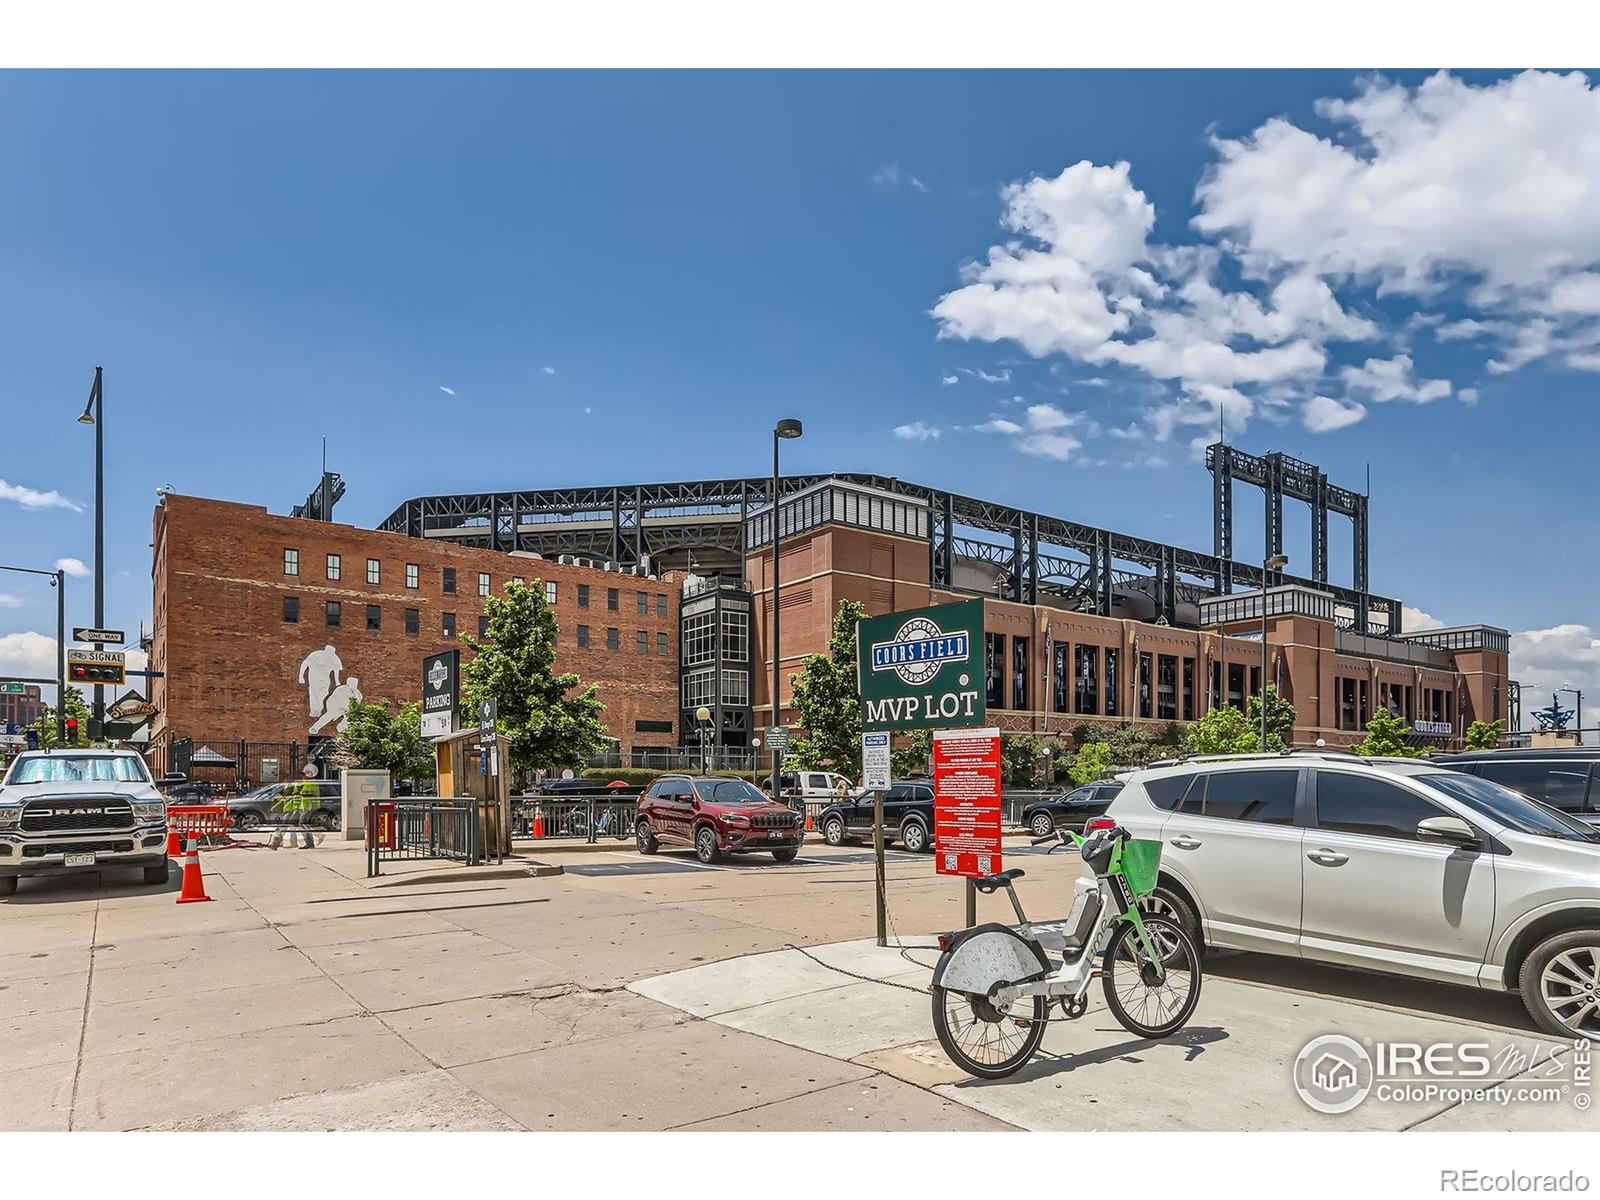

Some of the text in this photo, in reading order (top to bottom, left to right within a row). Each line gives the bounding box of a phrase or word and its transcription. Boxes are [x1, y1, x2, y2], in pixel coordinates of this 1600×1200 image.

[89, 652, 122, 662] SIGNAL
[876, 637, 964, 665] COORS FIELD
[425, 693, 451, 710] PARKING
[866, 691, 978, 723] MVP LOT
[55, 808, 102, 816] RAM
